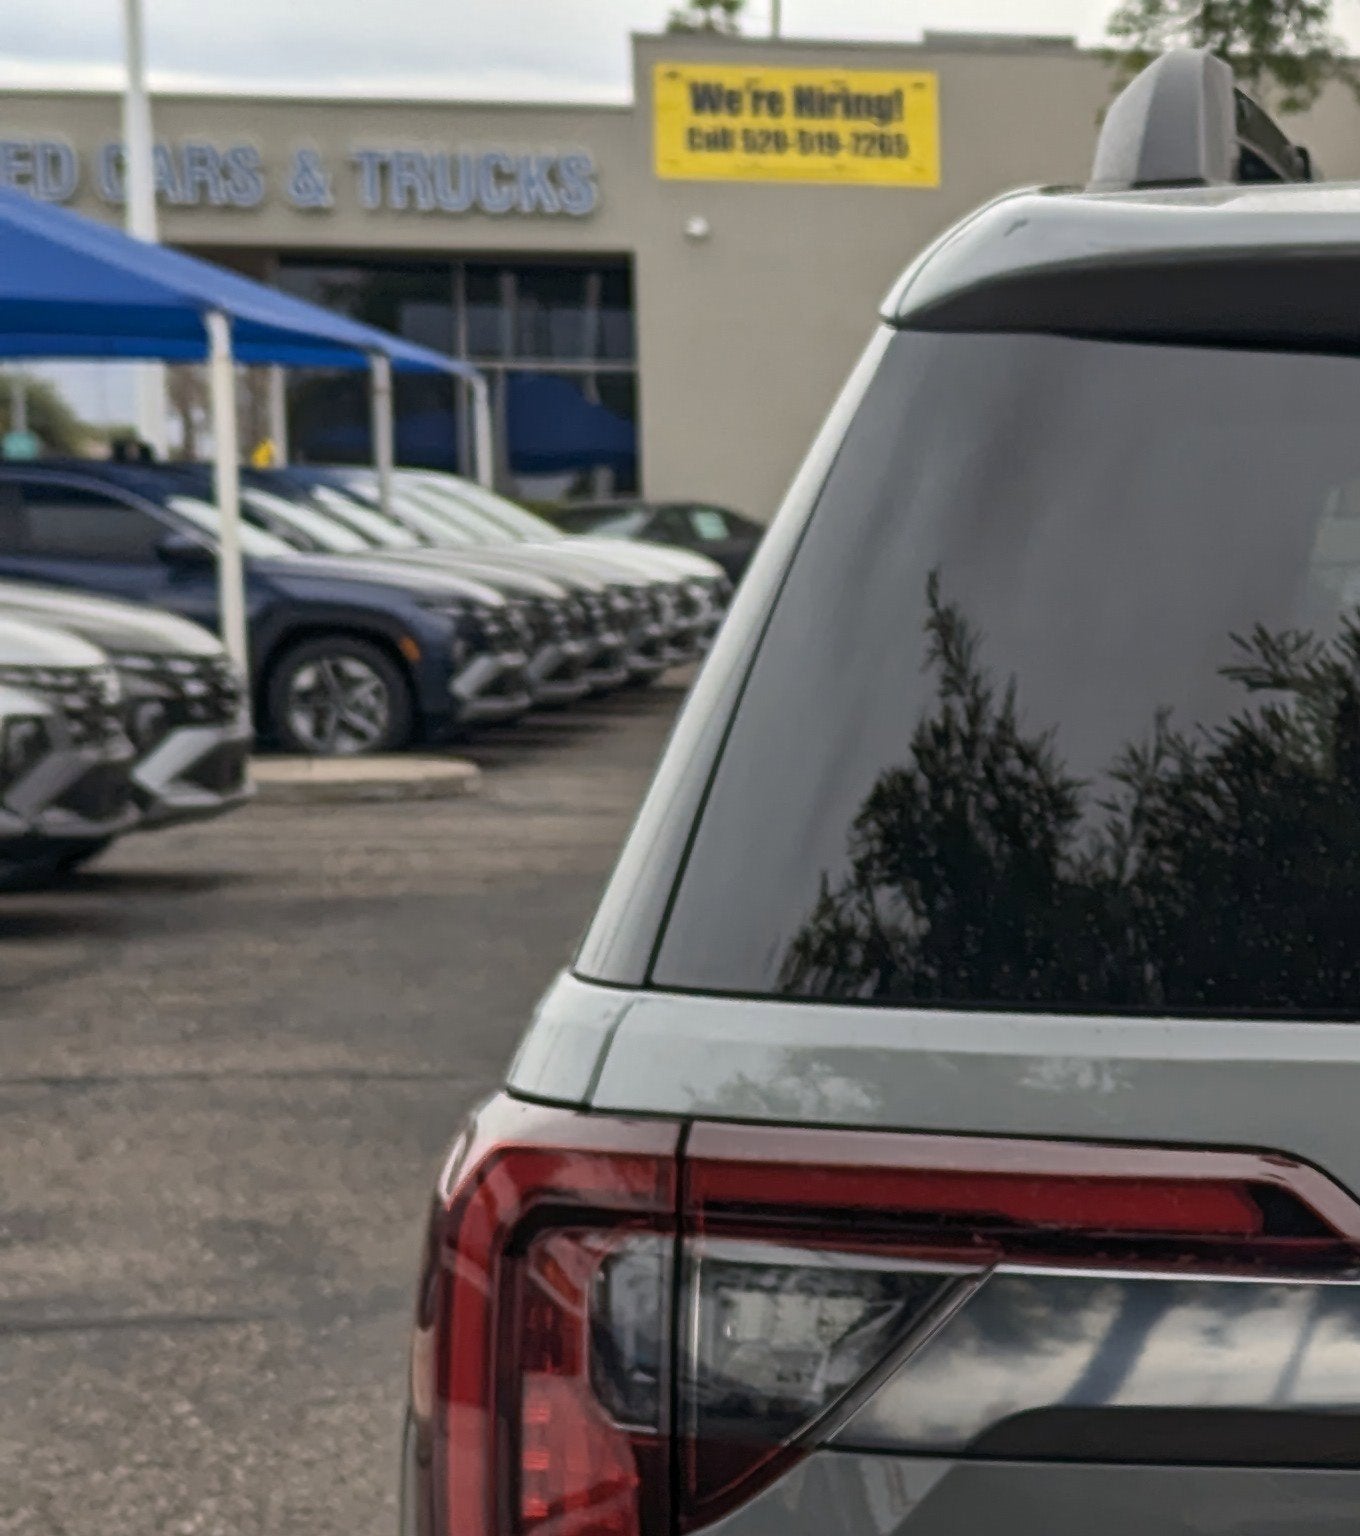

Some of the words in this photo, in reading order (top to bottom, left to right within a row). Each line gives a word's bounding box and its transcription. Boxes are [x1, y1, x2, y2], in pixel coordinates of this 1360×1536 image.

[689, 81, 785, 118] We're
[793, 84, 905, 126] Hiring!
[686, 126, 735, 152] Call
[95, 142, 264, 207] CARS
[287, 146, 333, 207] &
[352, 149, 597, 214] TRUCKS
